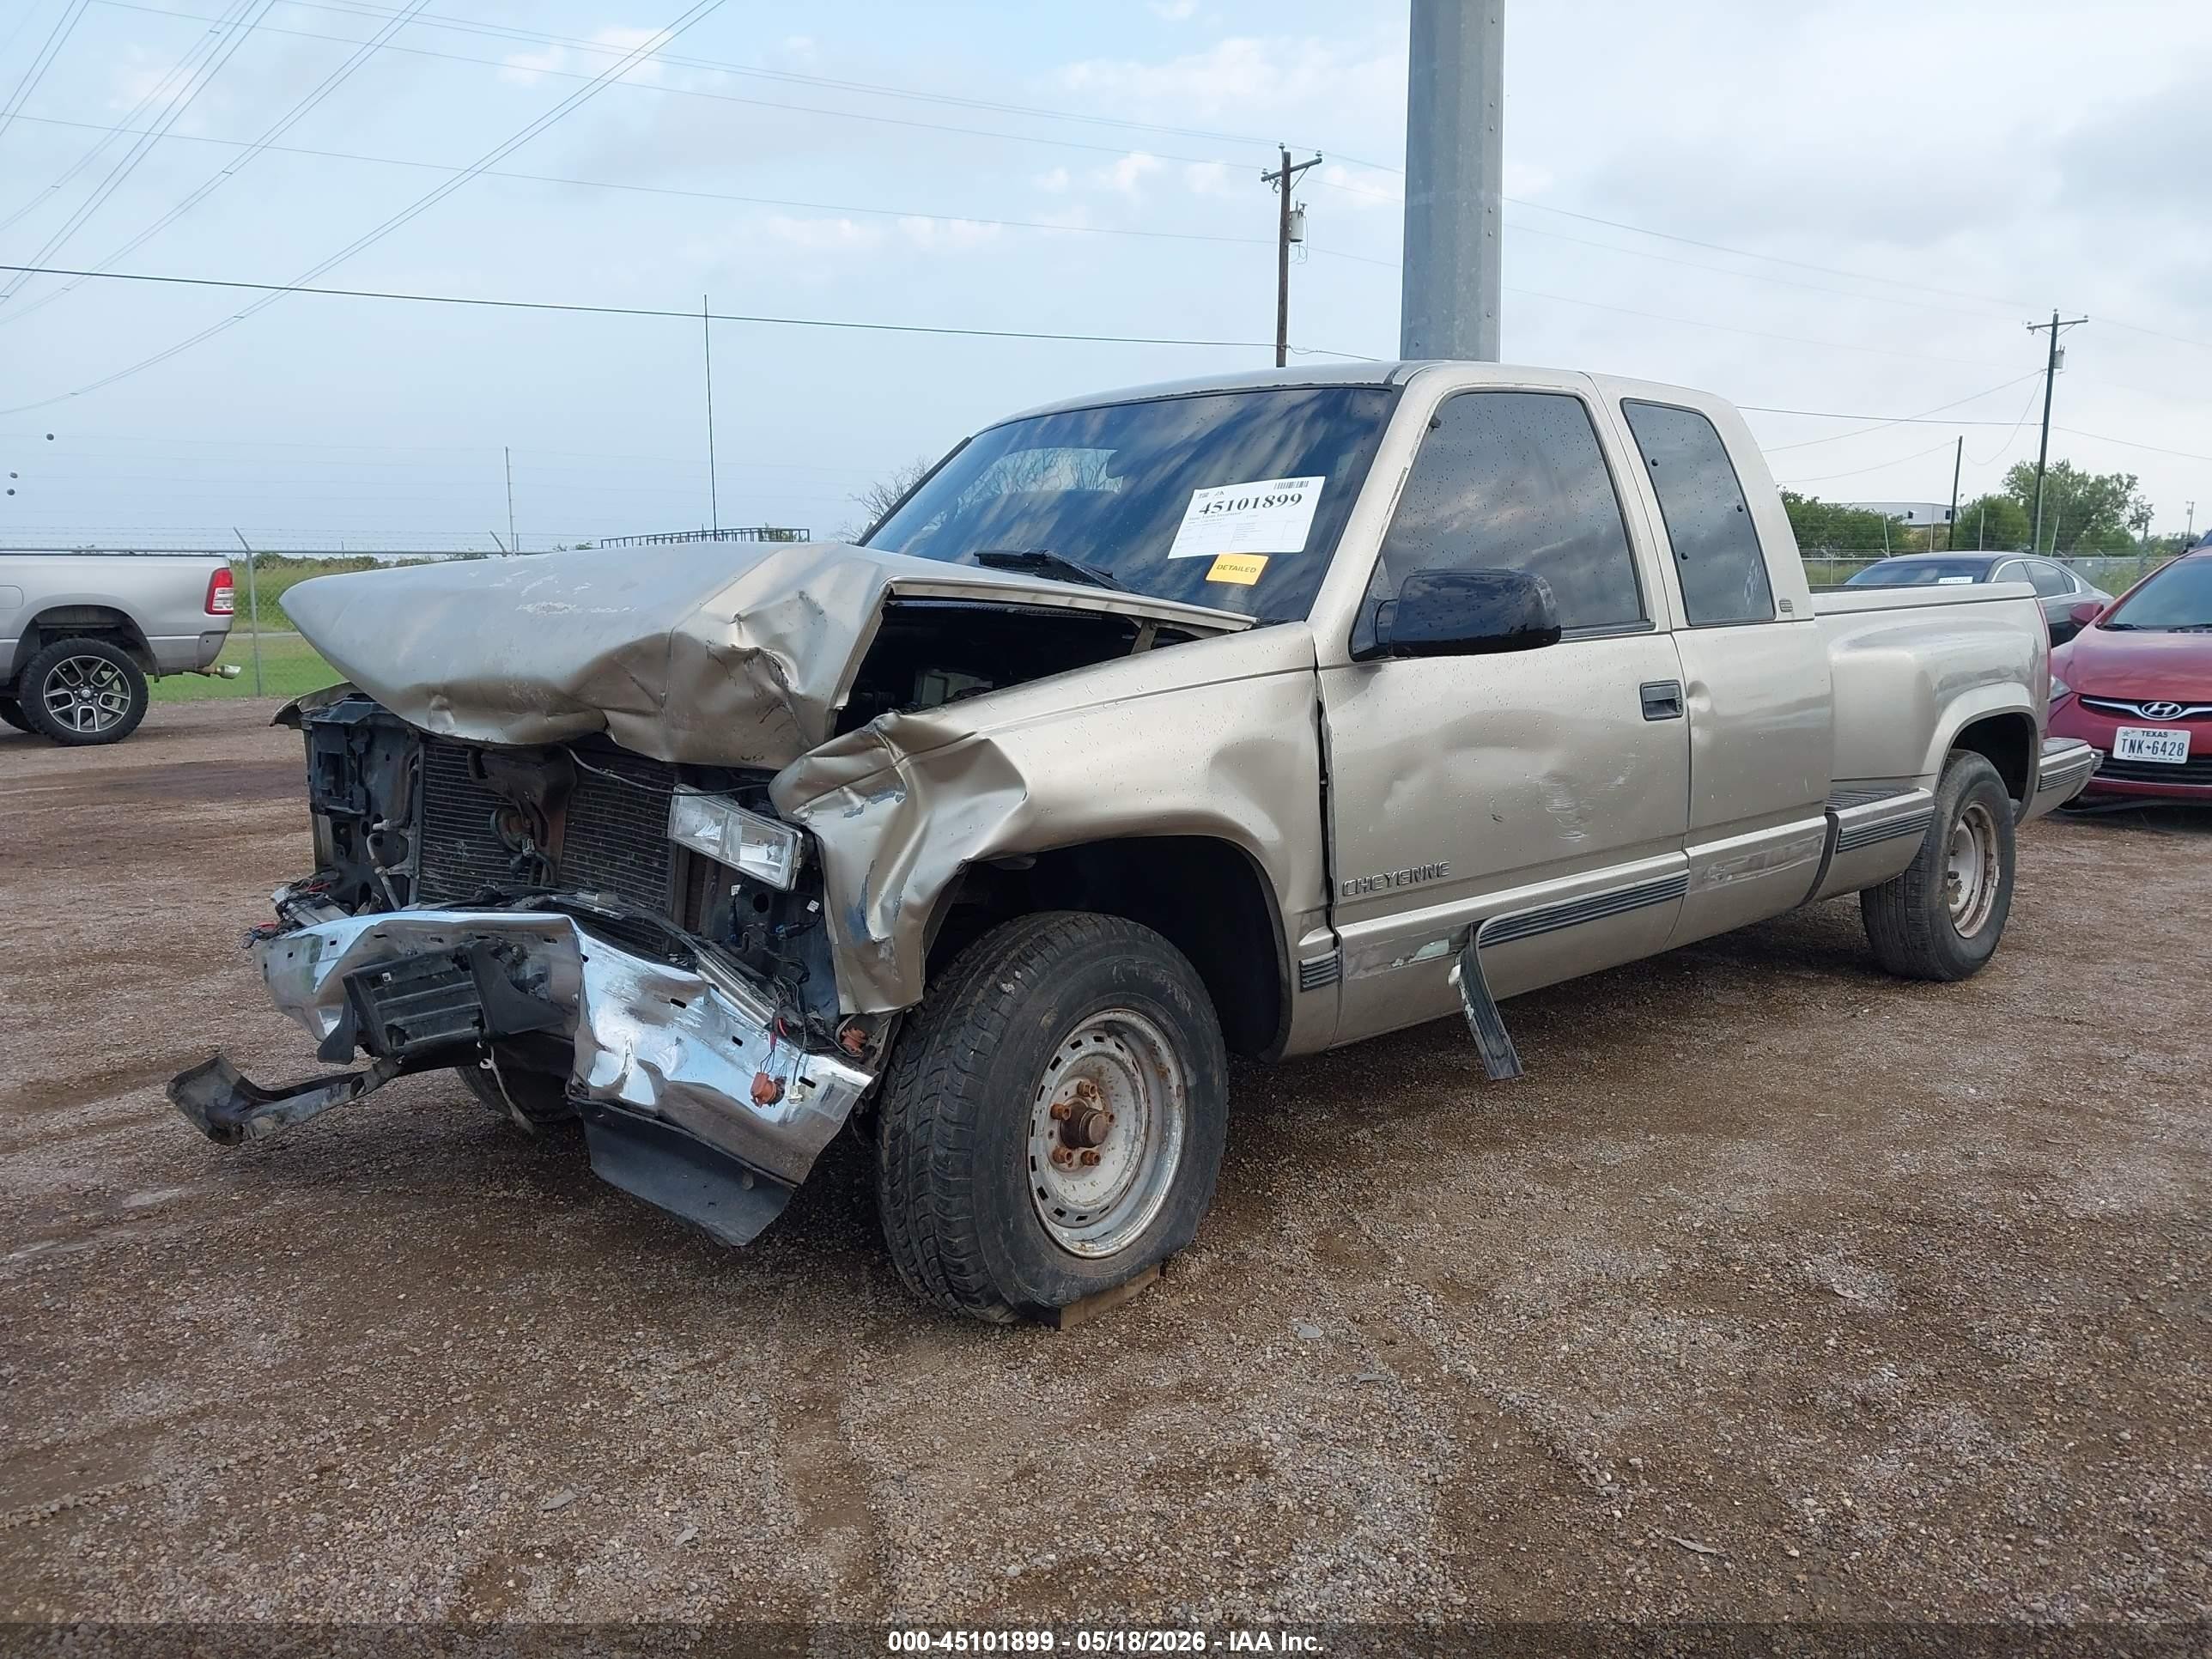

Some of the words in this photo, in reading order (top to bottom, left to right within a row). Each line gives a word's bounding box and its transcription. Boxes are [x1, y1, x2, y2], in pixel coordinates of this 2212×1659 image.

[1199, 493, 1302, 514] 45101899
[1216, 564, 1256, 573] DETAILED
[1342, 860, 1450, 896] CHEYENNE
